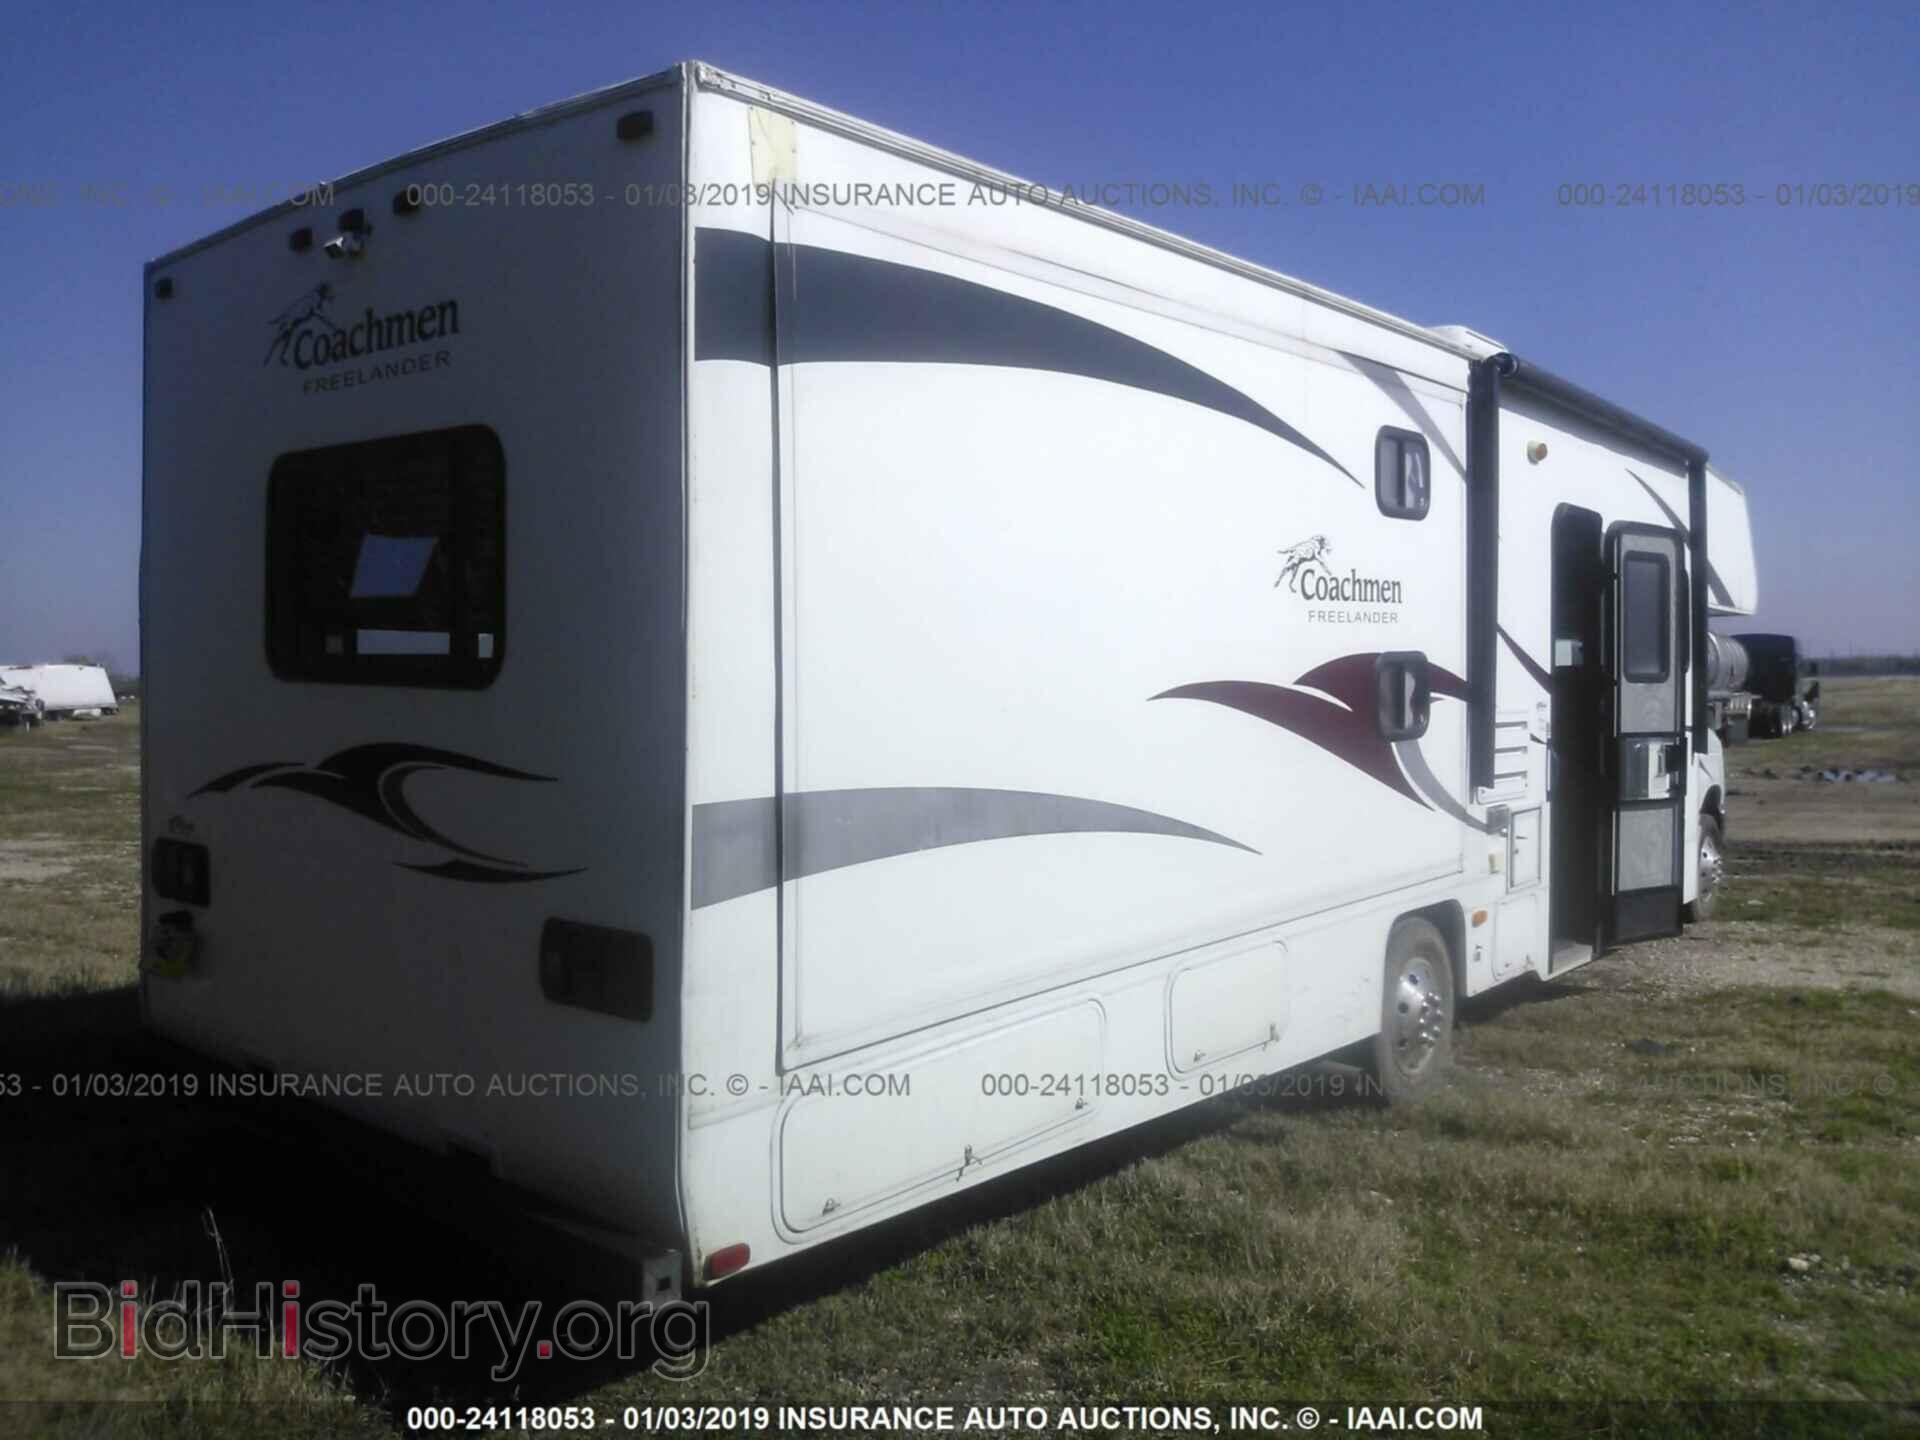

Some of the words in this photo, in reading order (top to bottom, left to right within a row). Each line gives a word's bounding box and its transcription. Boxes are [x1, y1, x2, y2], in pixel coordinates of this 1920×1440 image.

[294, 300, 459, 369] Coachmen
[303, 350, 451, 394] FREELANDER
[1300, 568, 1402, 603] Coachmen
[1307, 610, 1399, 623] FREELANDER
